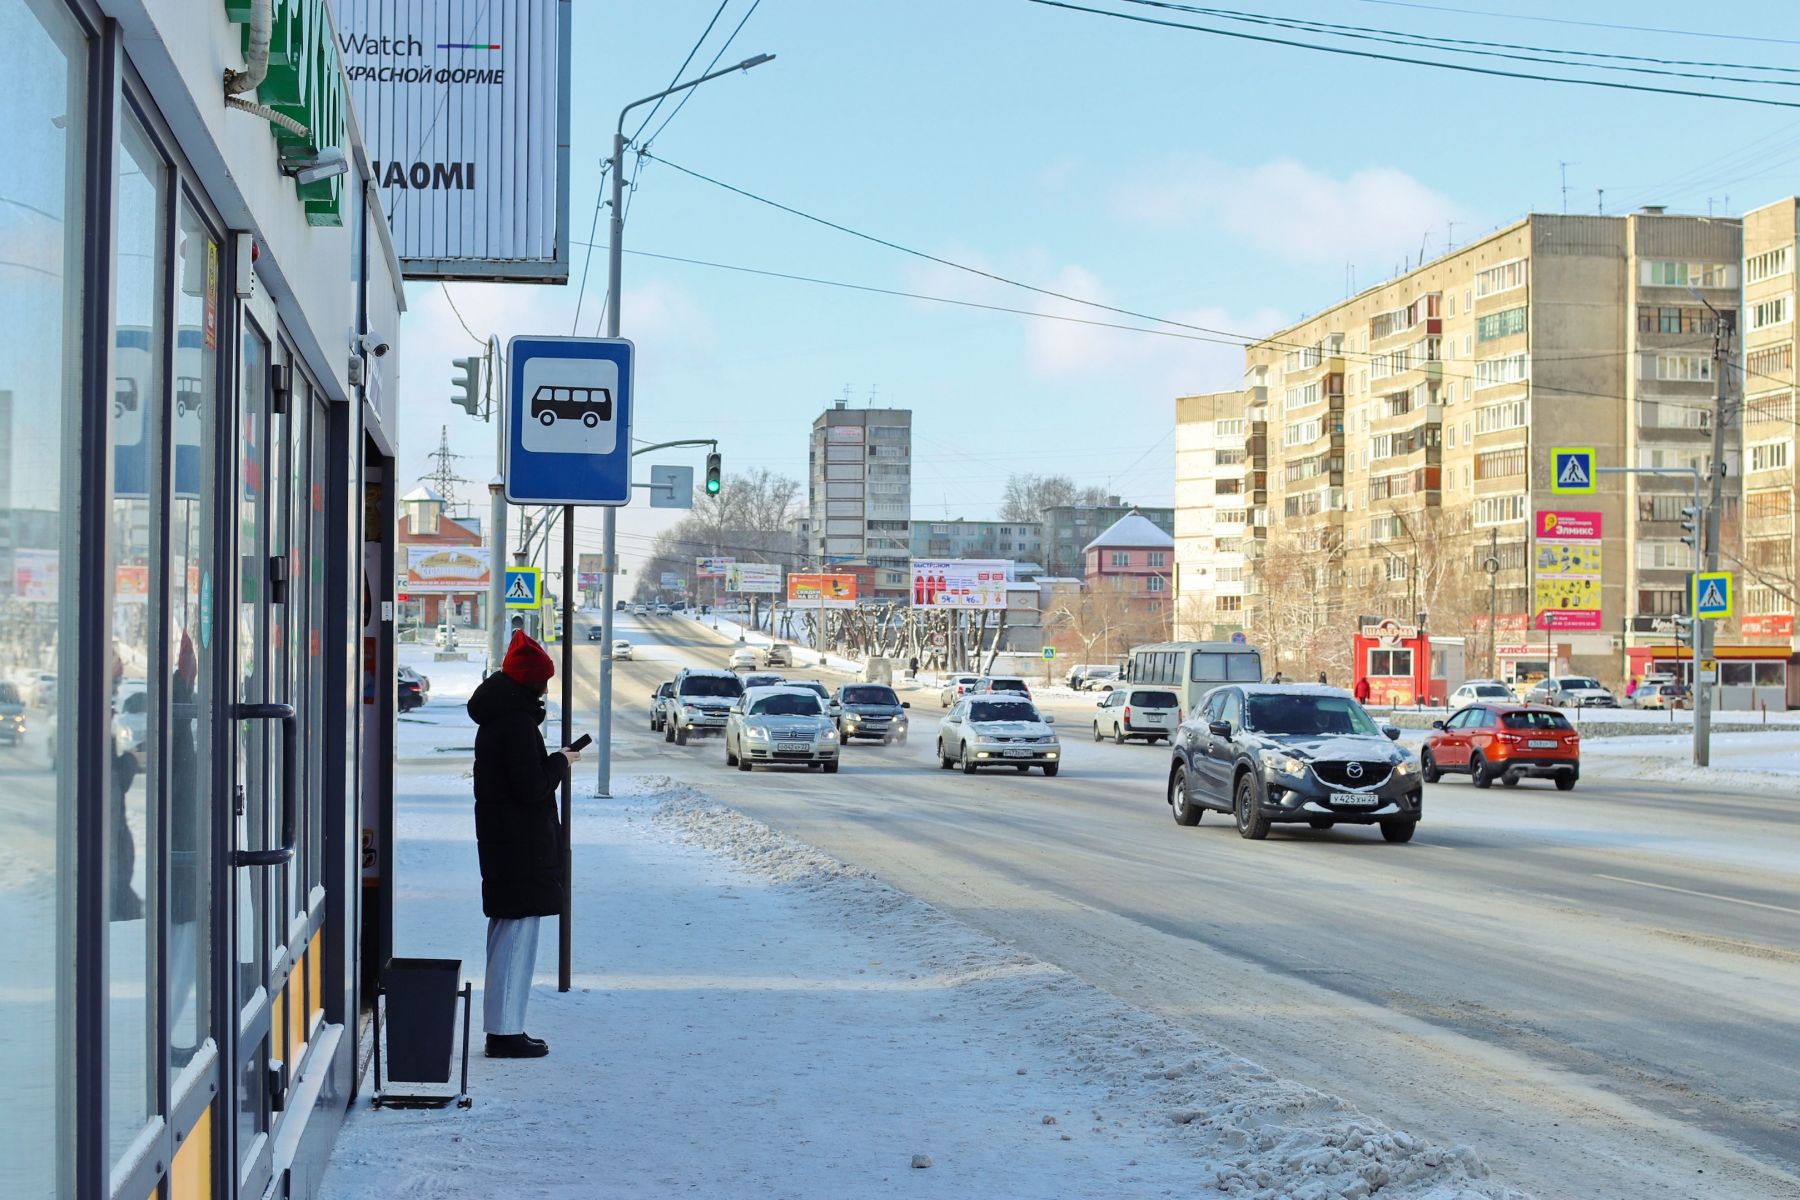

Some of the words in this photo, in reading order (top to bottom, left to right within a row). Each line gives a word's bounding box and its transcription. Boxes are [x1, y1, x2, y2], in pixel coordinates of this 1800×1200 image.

[338, 33, 422, 57] Watch
[434, 68, 504, 84] ФОРМЕ
[1555, 525, 1594, 535] Элмикс
[1365, 626, 1415, 636] ШАВЕРМА
